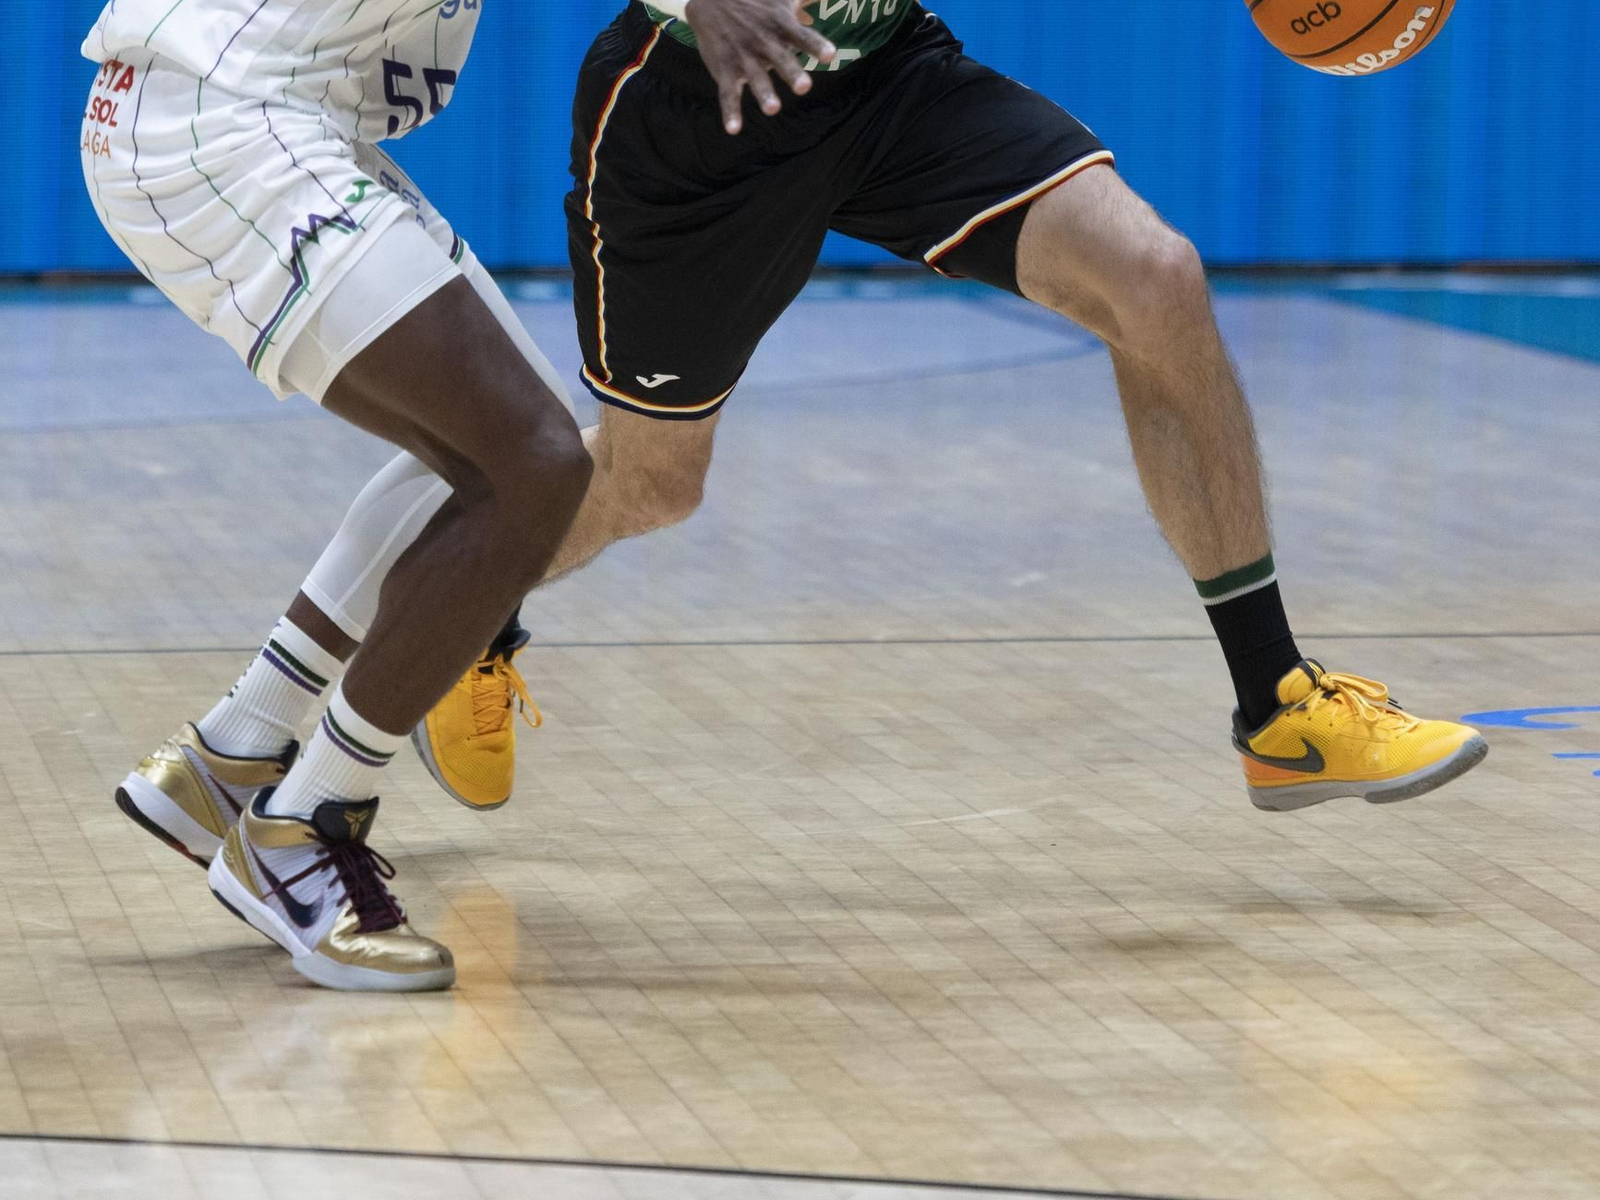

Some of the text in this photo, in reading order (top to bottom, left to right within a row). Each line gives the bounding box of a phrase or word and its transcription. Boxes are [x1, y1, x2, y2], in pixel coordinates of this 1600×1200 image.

[1290, 1, 1342, 35] acb
[96, 59, 135, 95] STA
[81, 129, 112, 159] AGA
